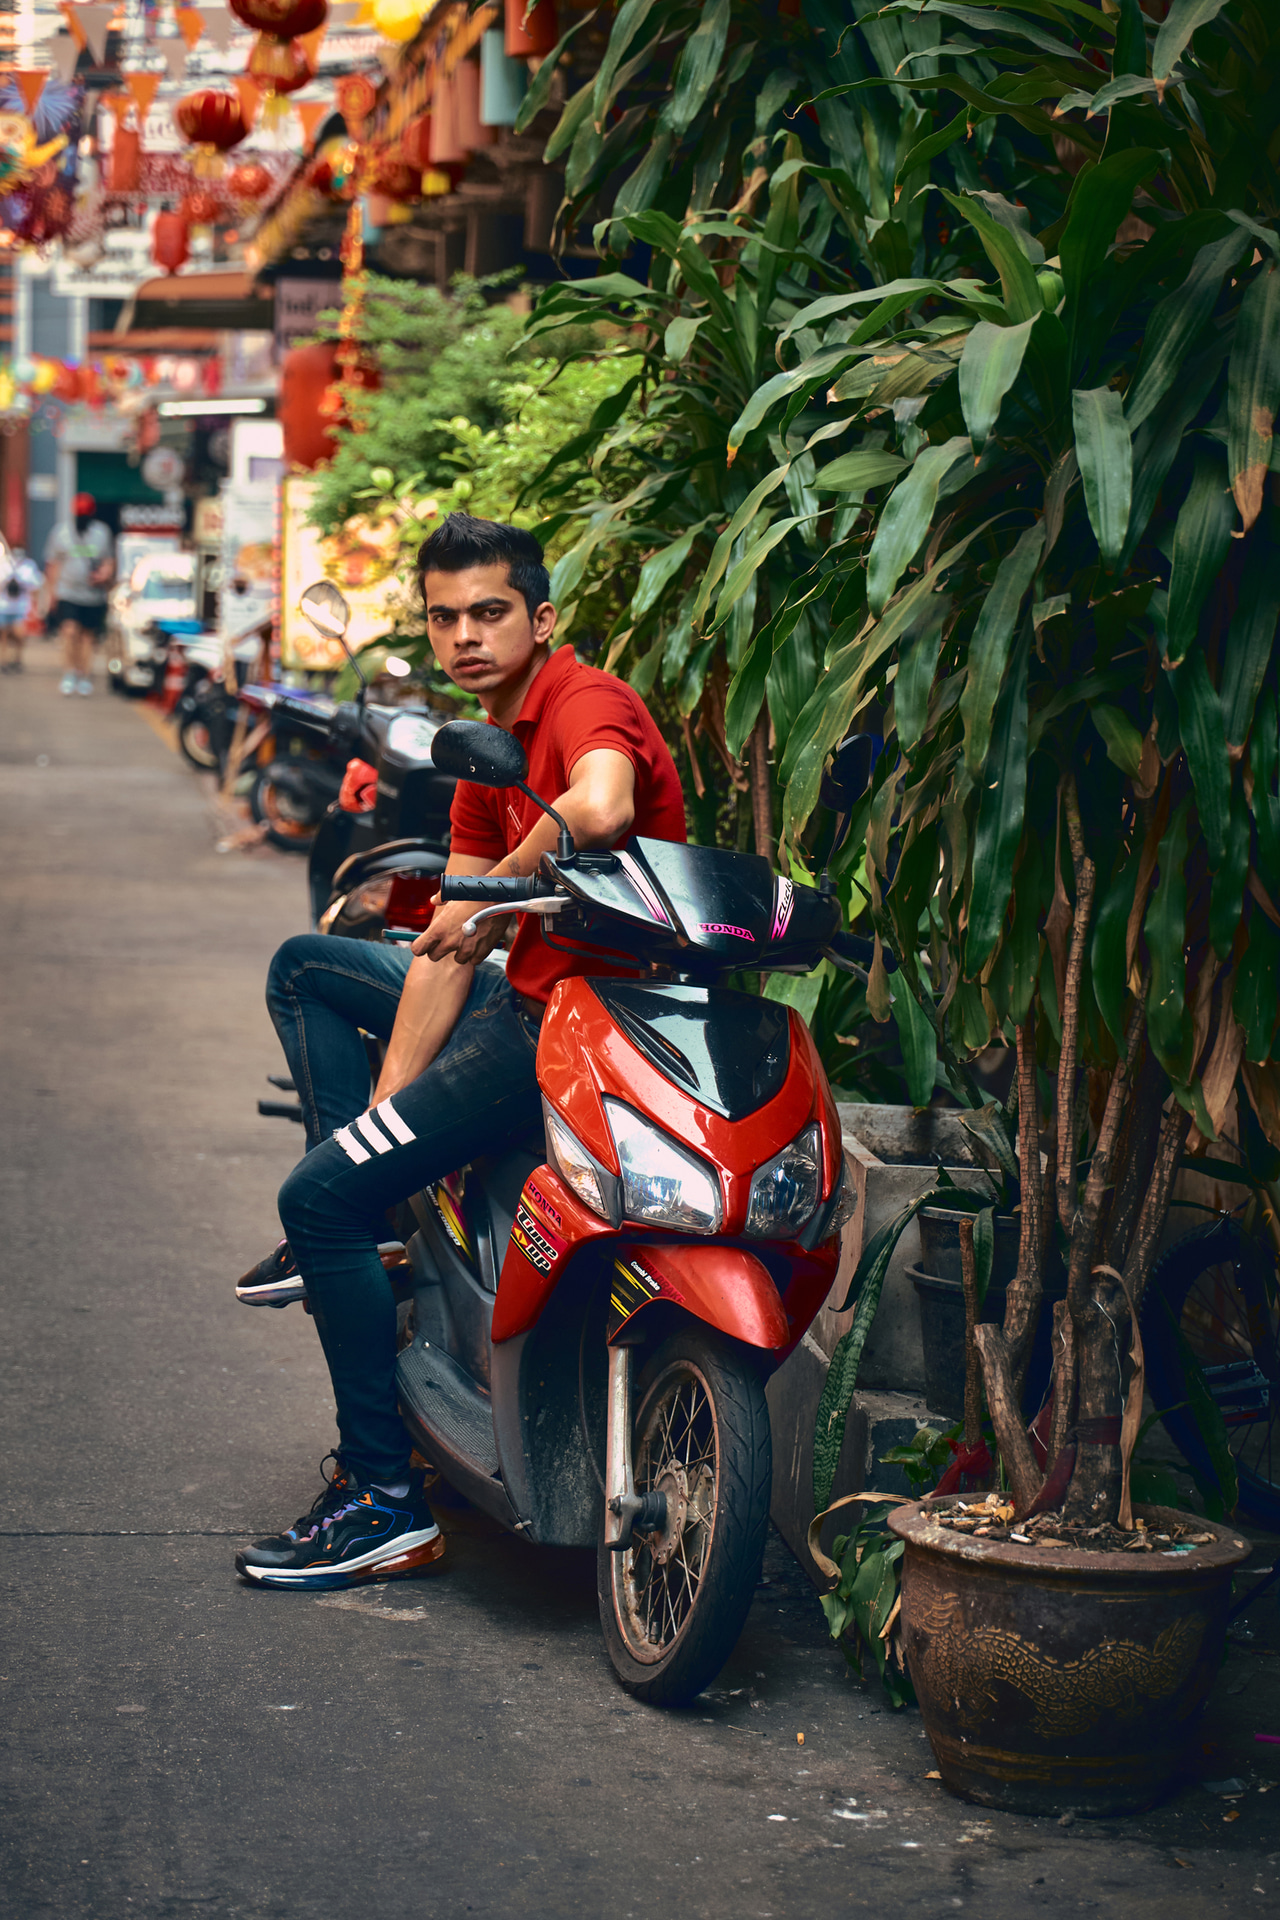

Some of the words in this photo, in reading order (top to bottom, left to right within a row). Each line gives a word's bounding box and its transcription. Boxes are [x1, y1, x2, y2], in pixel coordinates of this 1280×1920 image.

[699, 924, 754, 940] HONDA
[528, 1182, 562, 1228] HONDA
[630, 1260, 648, 1277] Combi
[644, 1275, 661, 1291] Brake
